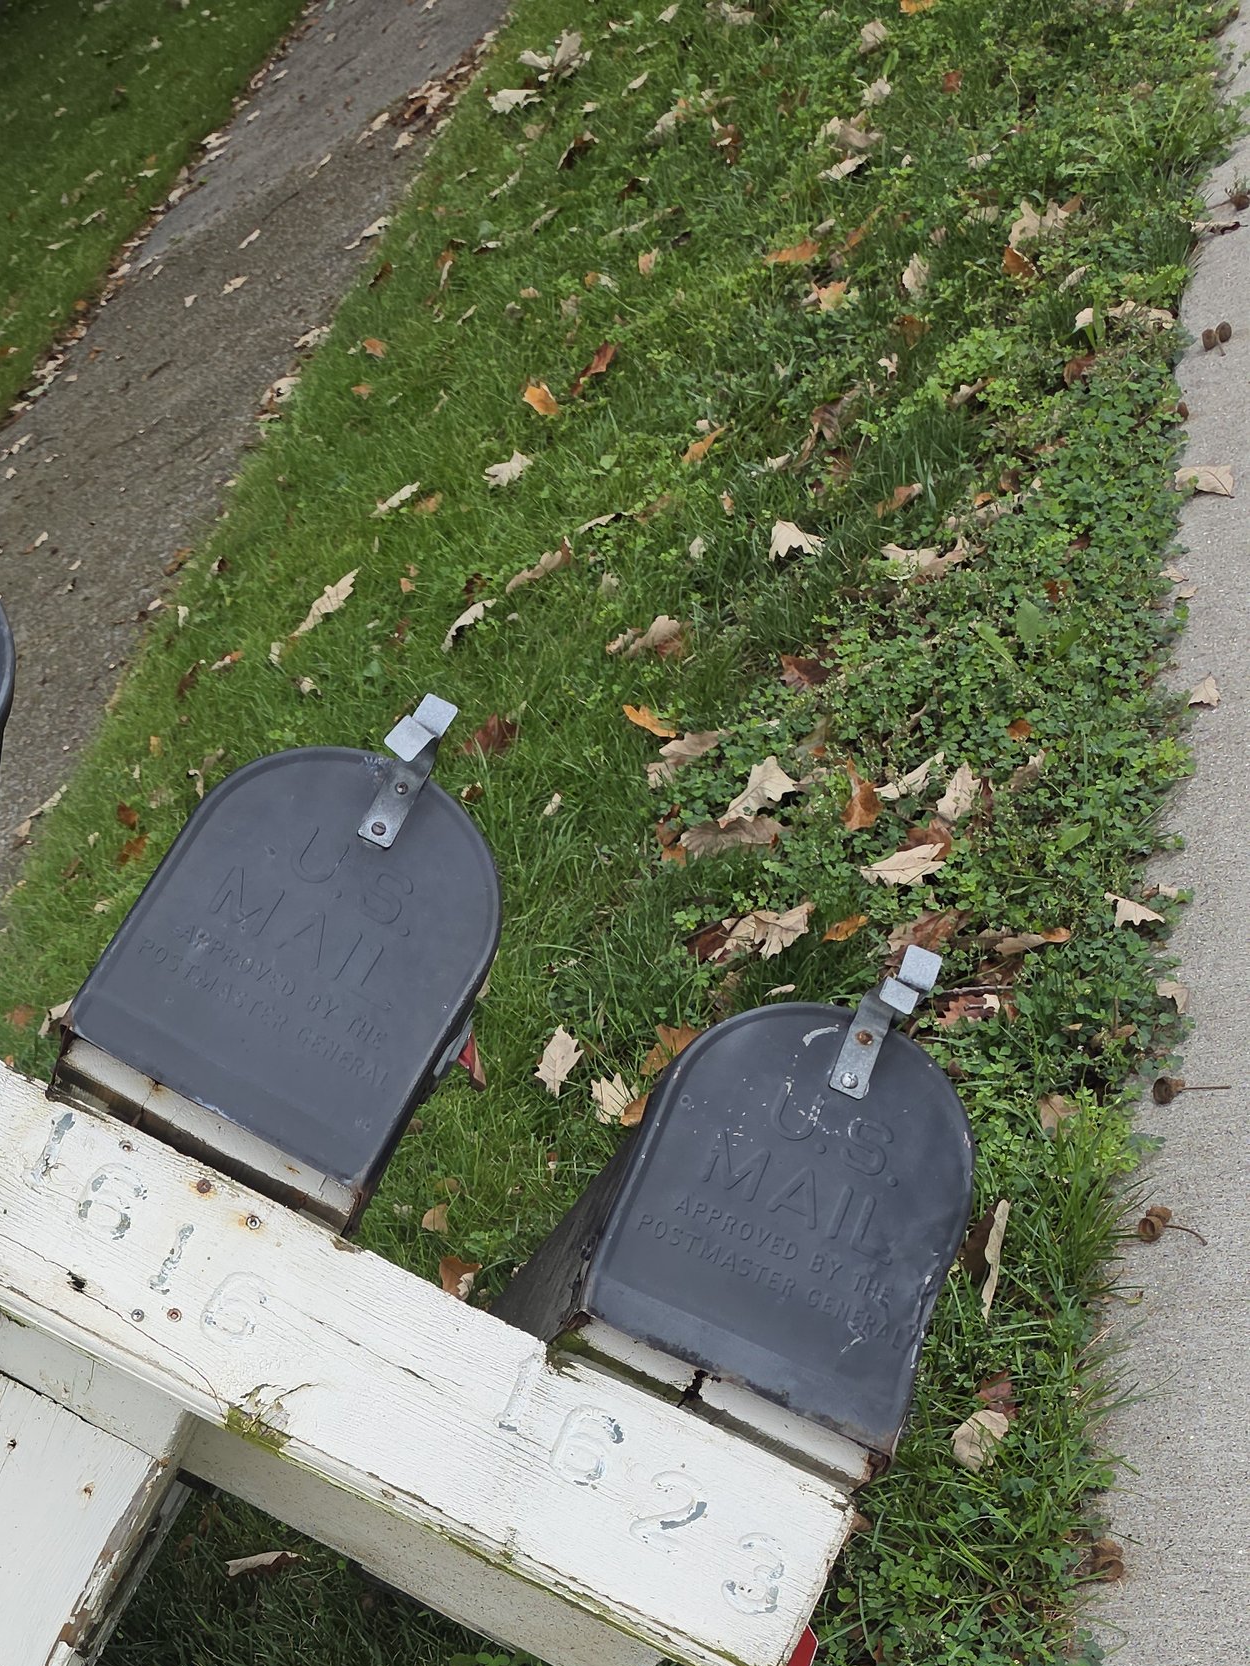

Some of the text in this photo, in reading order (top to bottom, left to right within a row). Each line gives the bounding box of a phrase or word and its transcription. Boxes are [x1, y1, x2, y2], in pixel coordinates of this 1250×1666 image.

[175, 924, 297, 999] APPROVED
[208, 863, 393, 1011] MAIL
[136, 937, 290, 1032] POSTMASTER
[306, 993, 340, 1020] BY
[296, 1025, 391, 1089] GENERAL
[346, 1013, 390, 1051] THE
[21, 1111, 269, 1344] 1616
[674, 1193, 800, 1263] APPROVED
[701, 1127, 894, 1268] MAIL
[636, 1213, 796, 1299] POSTMASTER
[808, 1250, 844, 1281] BY
[851, 1271, 894, 1308] THE
[806, 1286, 918, 1352] GENERAL
[493, 1352, 786, 1616] 1623
